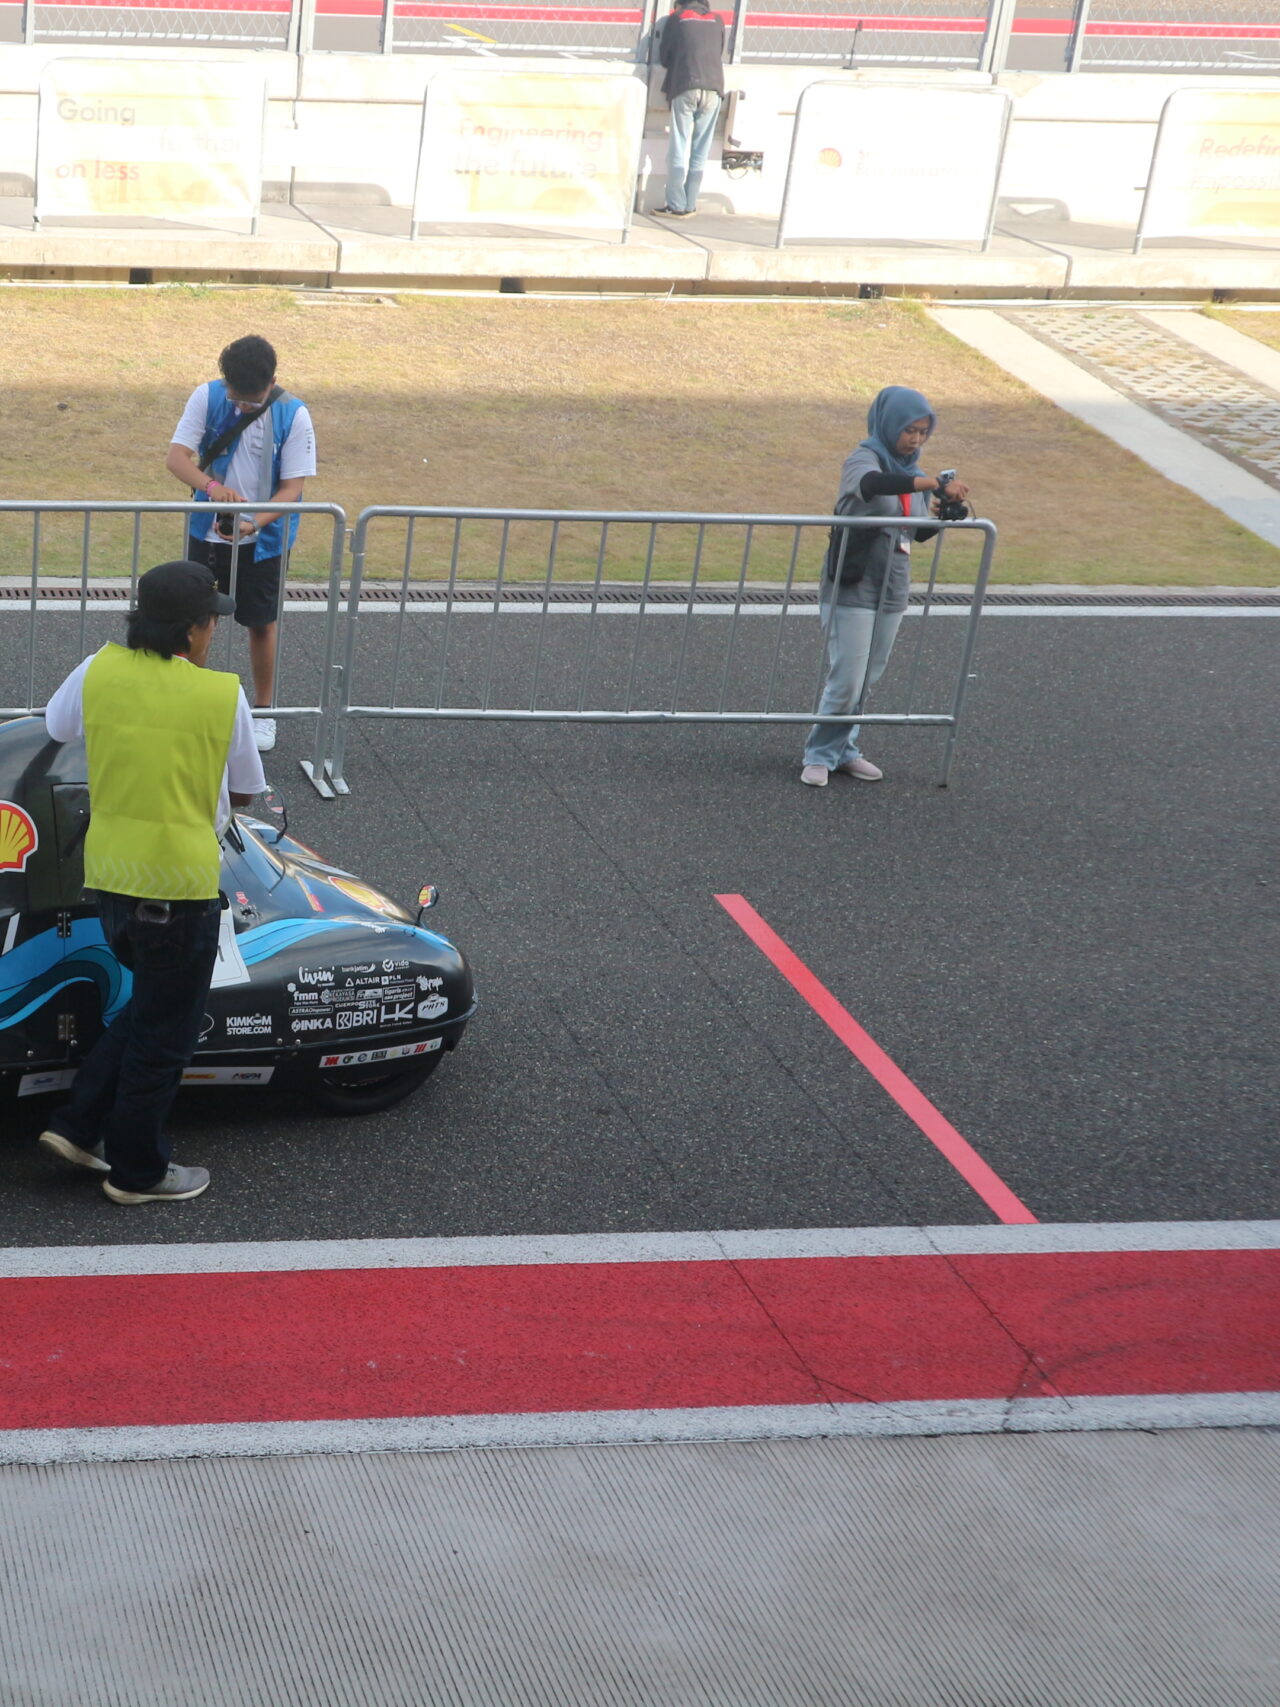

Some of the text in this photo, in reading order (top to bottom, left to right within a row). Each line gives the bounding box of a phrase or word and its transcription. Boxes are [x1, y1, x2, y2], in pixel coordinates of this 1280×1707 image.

[56, 98, 136, 126] Going
[459, 118, 604, 152] Engineering
[55, 156, 140, 181] on less
[355, 976, 380, 985] ALTAIR
[293, 991, 319, 1001] fmm
[301, 1018, 333, 1031] INKA
[352, 1009, 378, 1026] BRI
[226, 1026, 272, 1035] STORE.COM
